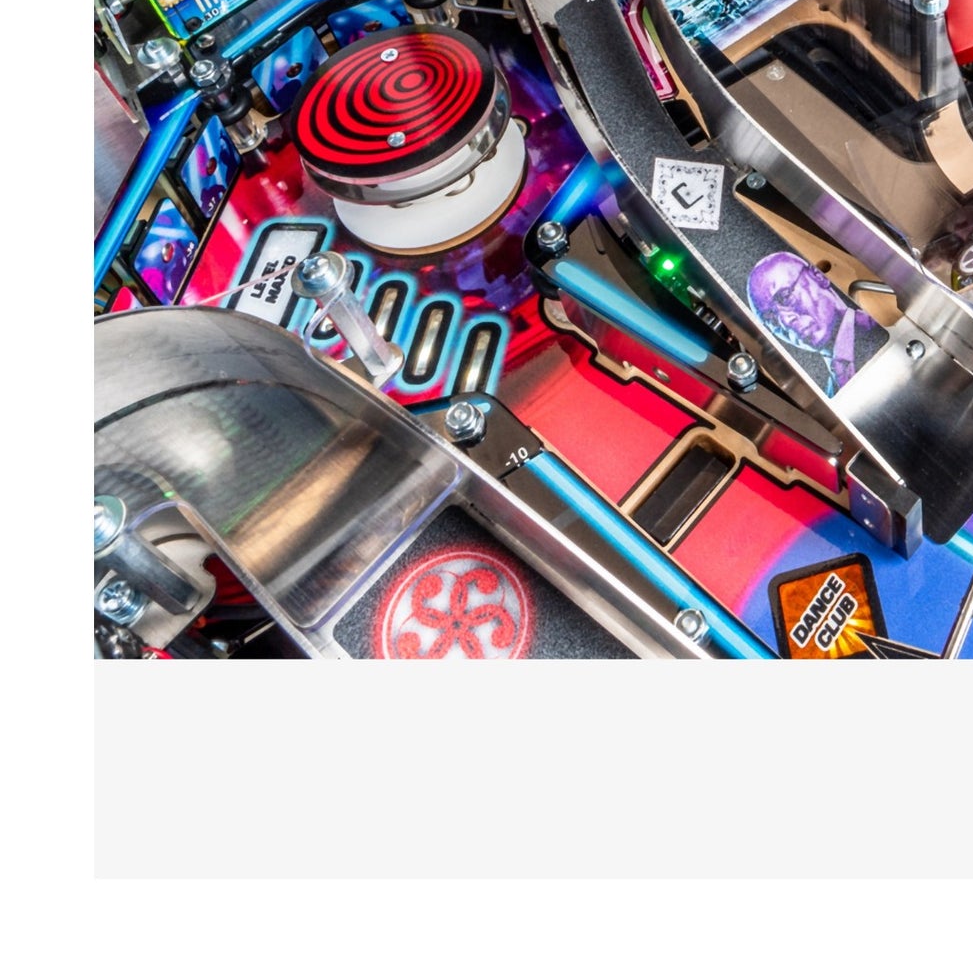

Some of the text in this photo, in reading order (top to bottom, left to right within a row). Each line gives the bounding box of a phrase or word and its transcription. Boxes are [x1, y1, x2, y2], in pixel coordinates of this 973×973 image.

[505, 447, 529, 467] -10
[792, 575, 843, 645] DANCE
[817, 595, 856, 647] CLUB
